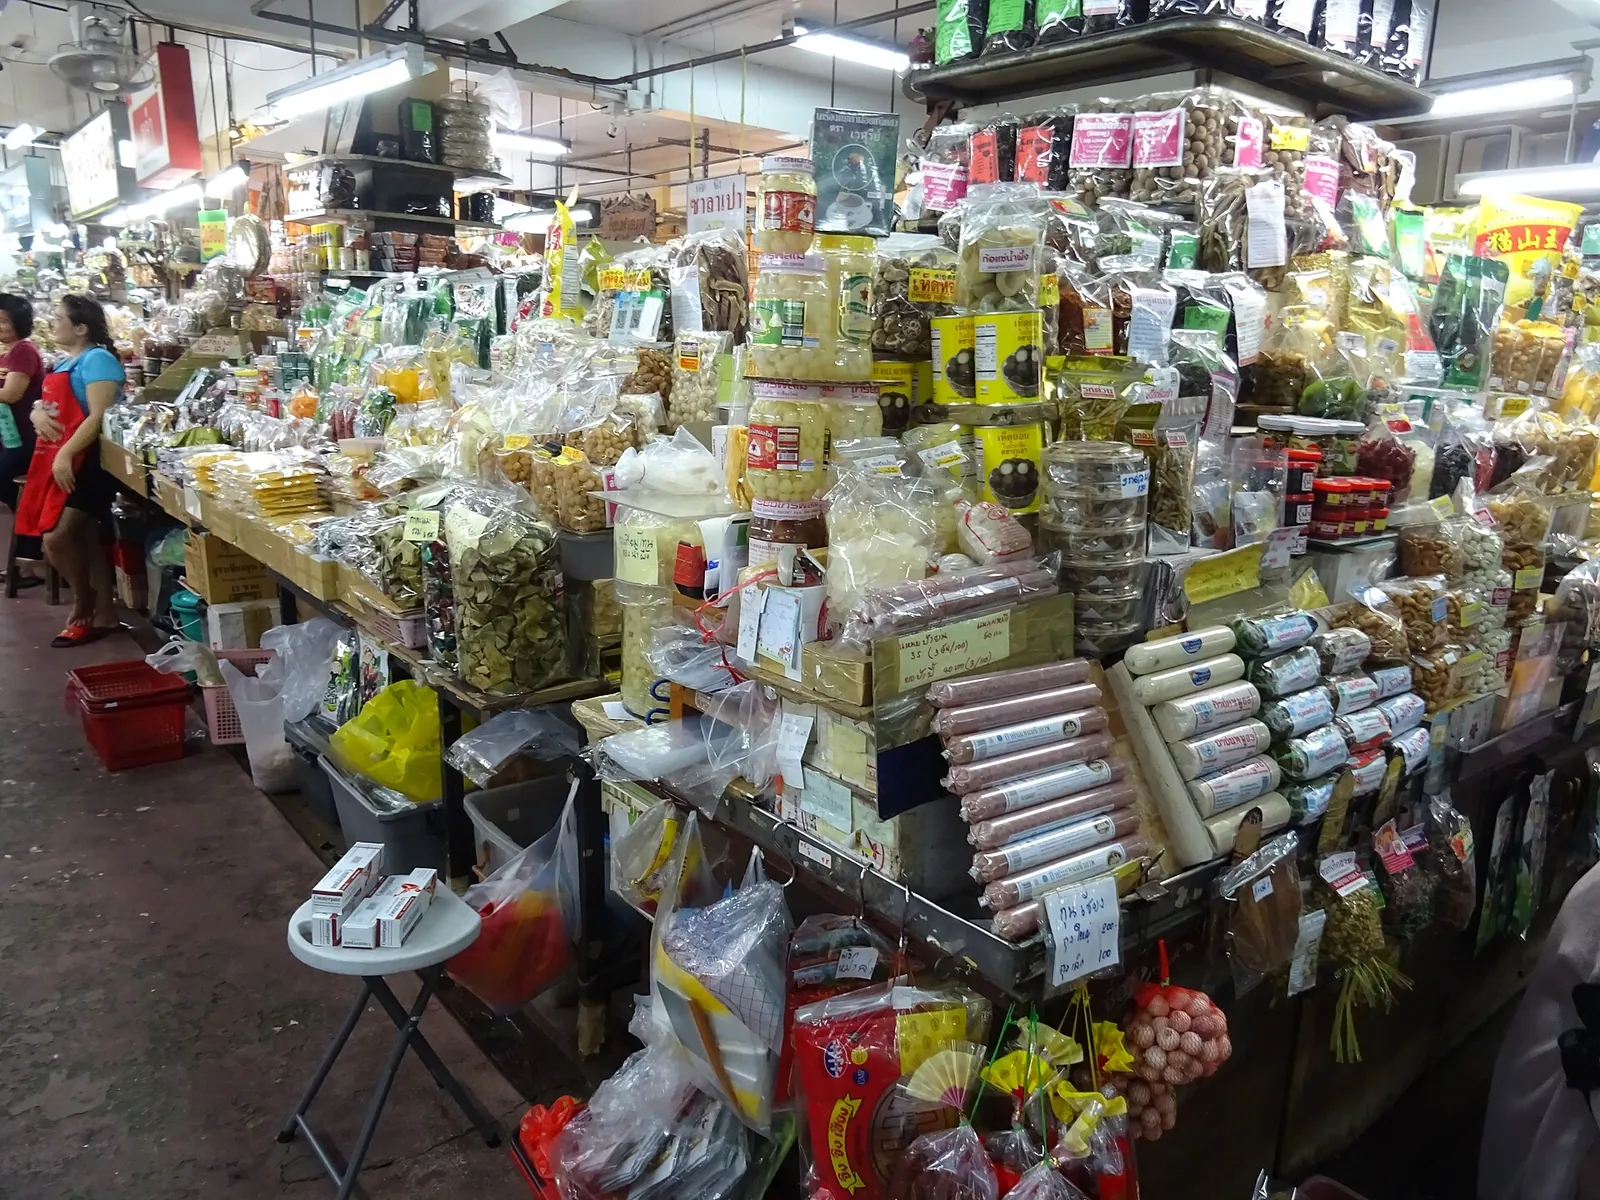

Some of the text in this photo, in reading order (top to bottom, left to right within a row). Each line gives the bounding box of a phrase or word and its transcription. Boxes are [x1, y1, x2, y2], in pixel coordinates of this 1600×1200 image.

[690, 182, 742, 215] ซาลาเปา
[912, 272, 955, 296] เห็ดหอ
[910, 651, 921, 660] 35
[1098, 948, 1112, 963] 100
[857, 1069, 866, 1086] GMP
